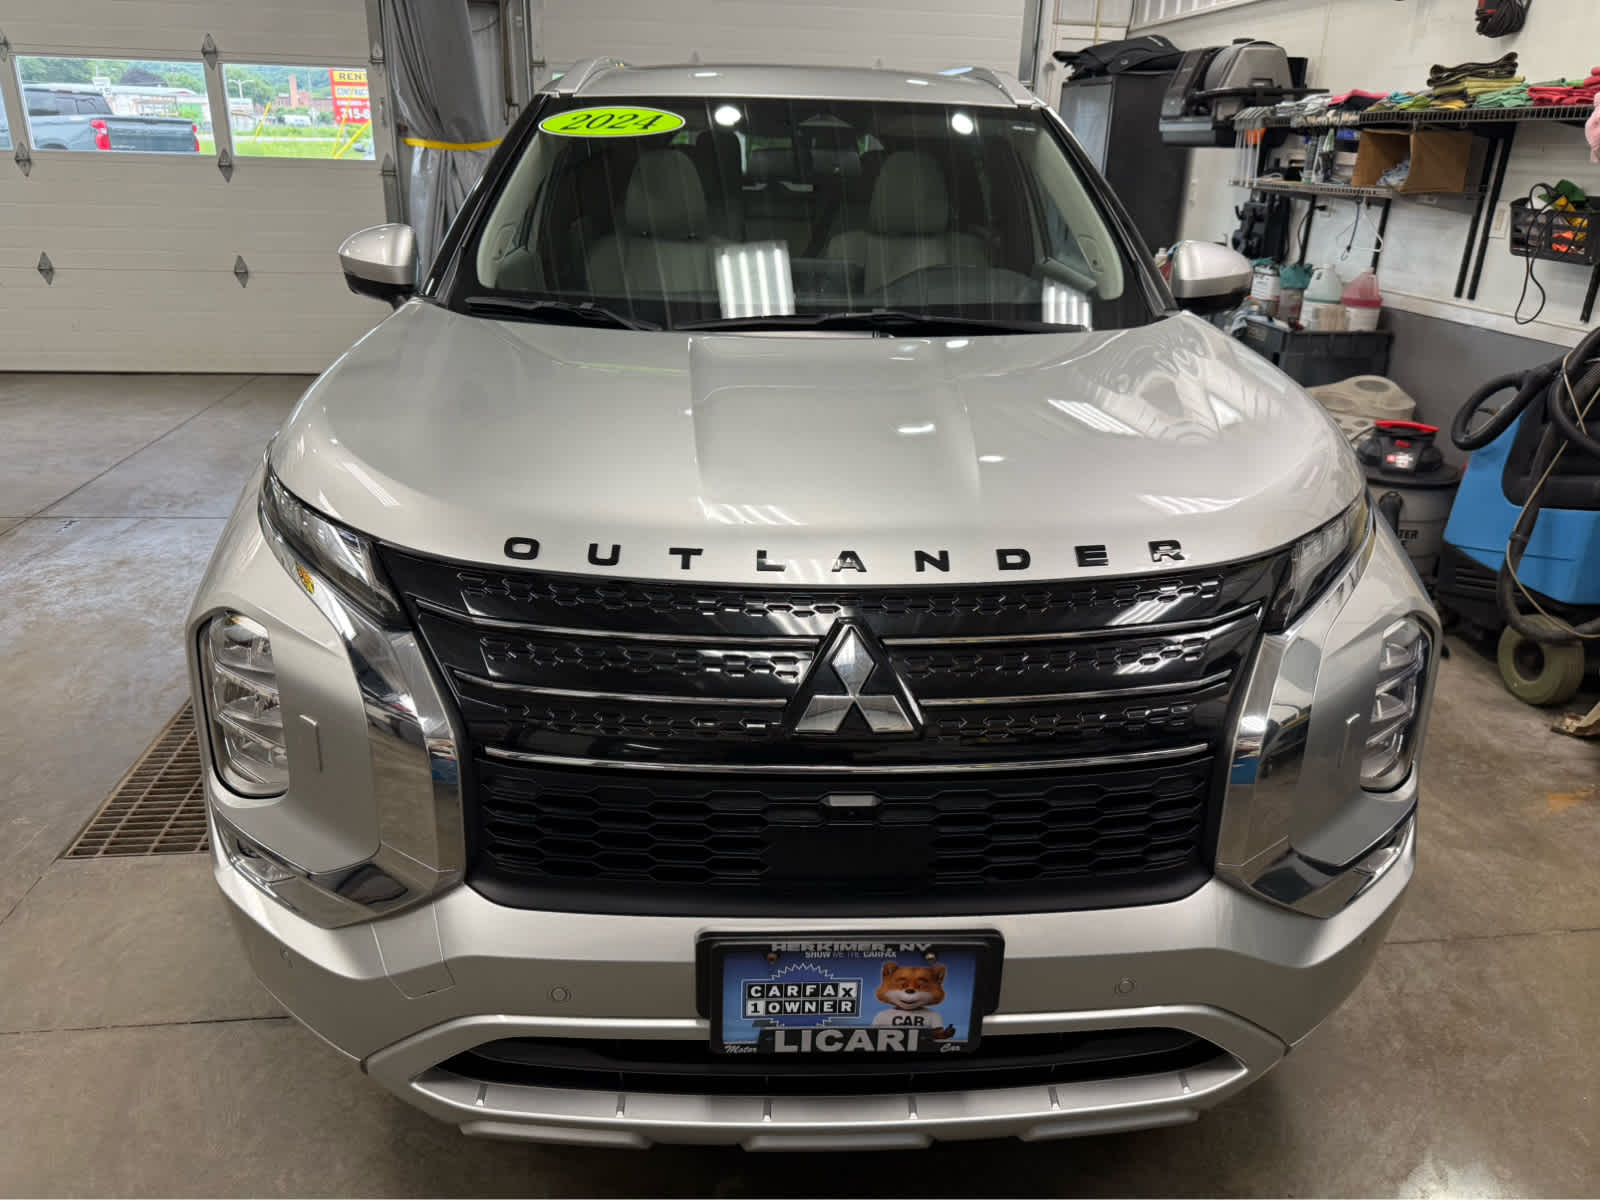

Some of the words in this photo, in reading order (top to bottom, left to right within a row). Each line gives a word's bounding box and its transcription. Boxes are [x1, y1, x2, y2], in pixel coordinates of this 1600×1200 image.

[559, 113, 663, 130] 2024
[504, 537, 1186, 572] OUTLANDER
[900, 943, 933, 952] NY
[750, 984, 857, 998] CARFAX
[892, 1016, 925, 1027] CAR
[774, 1029, 920, 1053] LICARI
